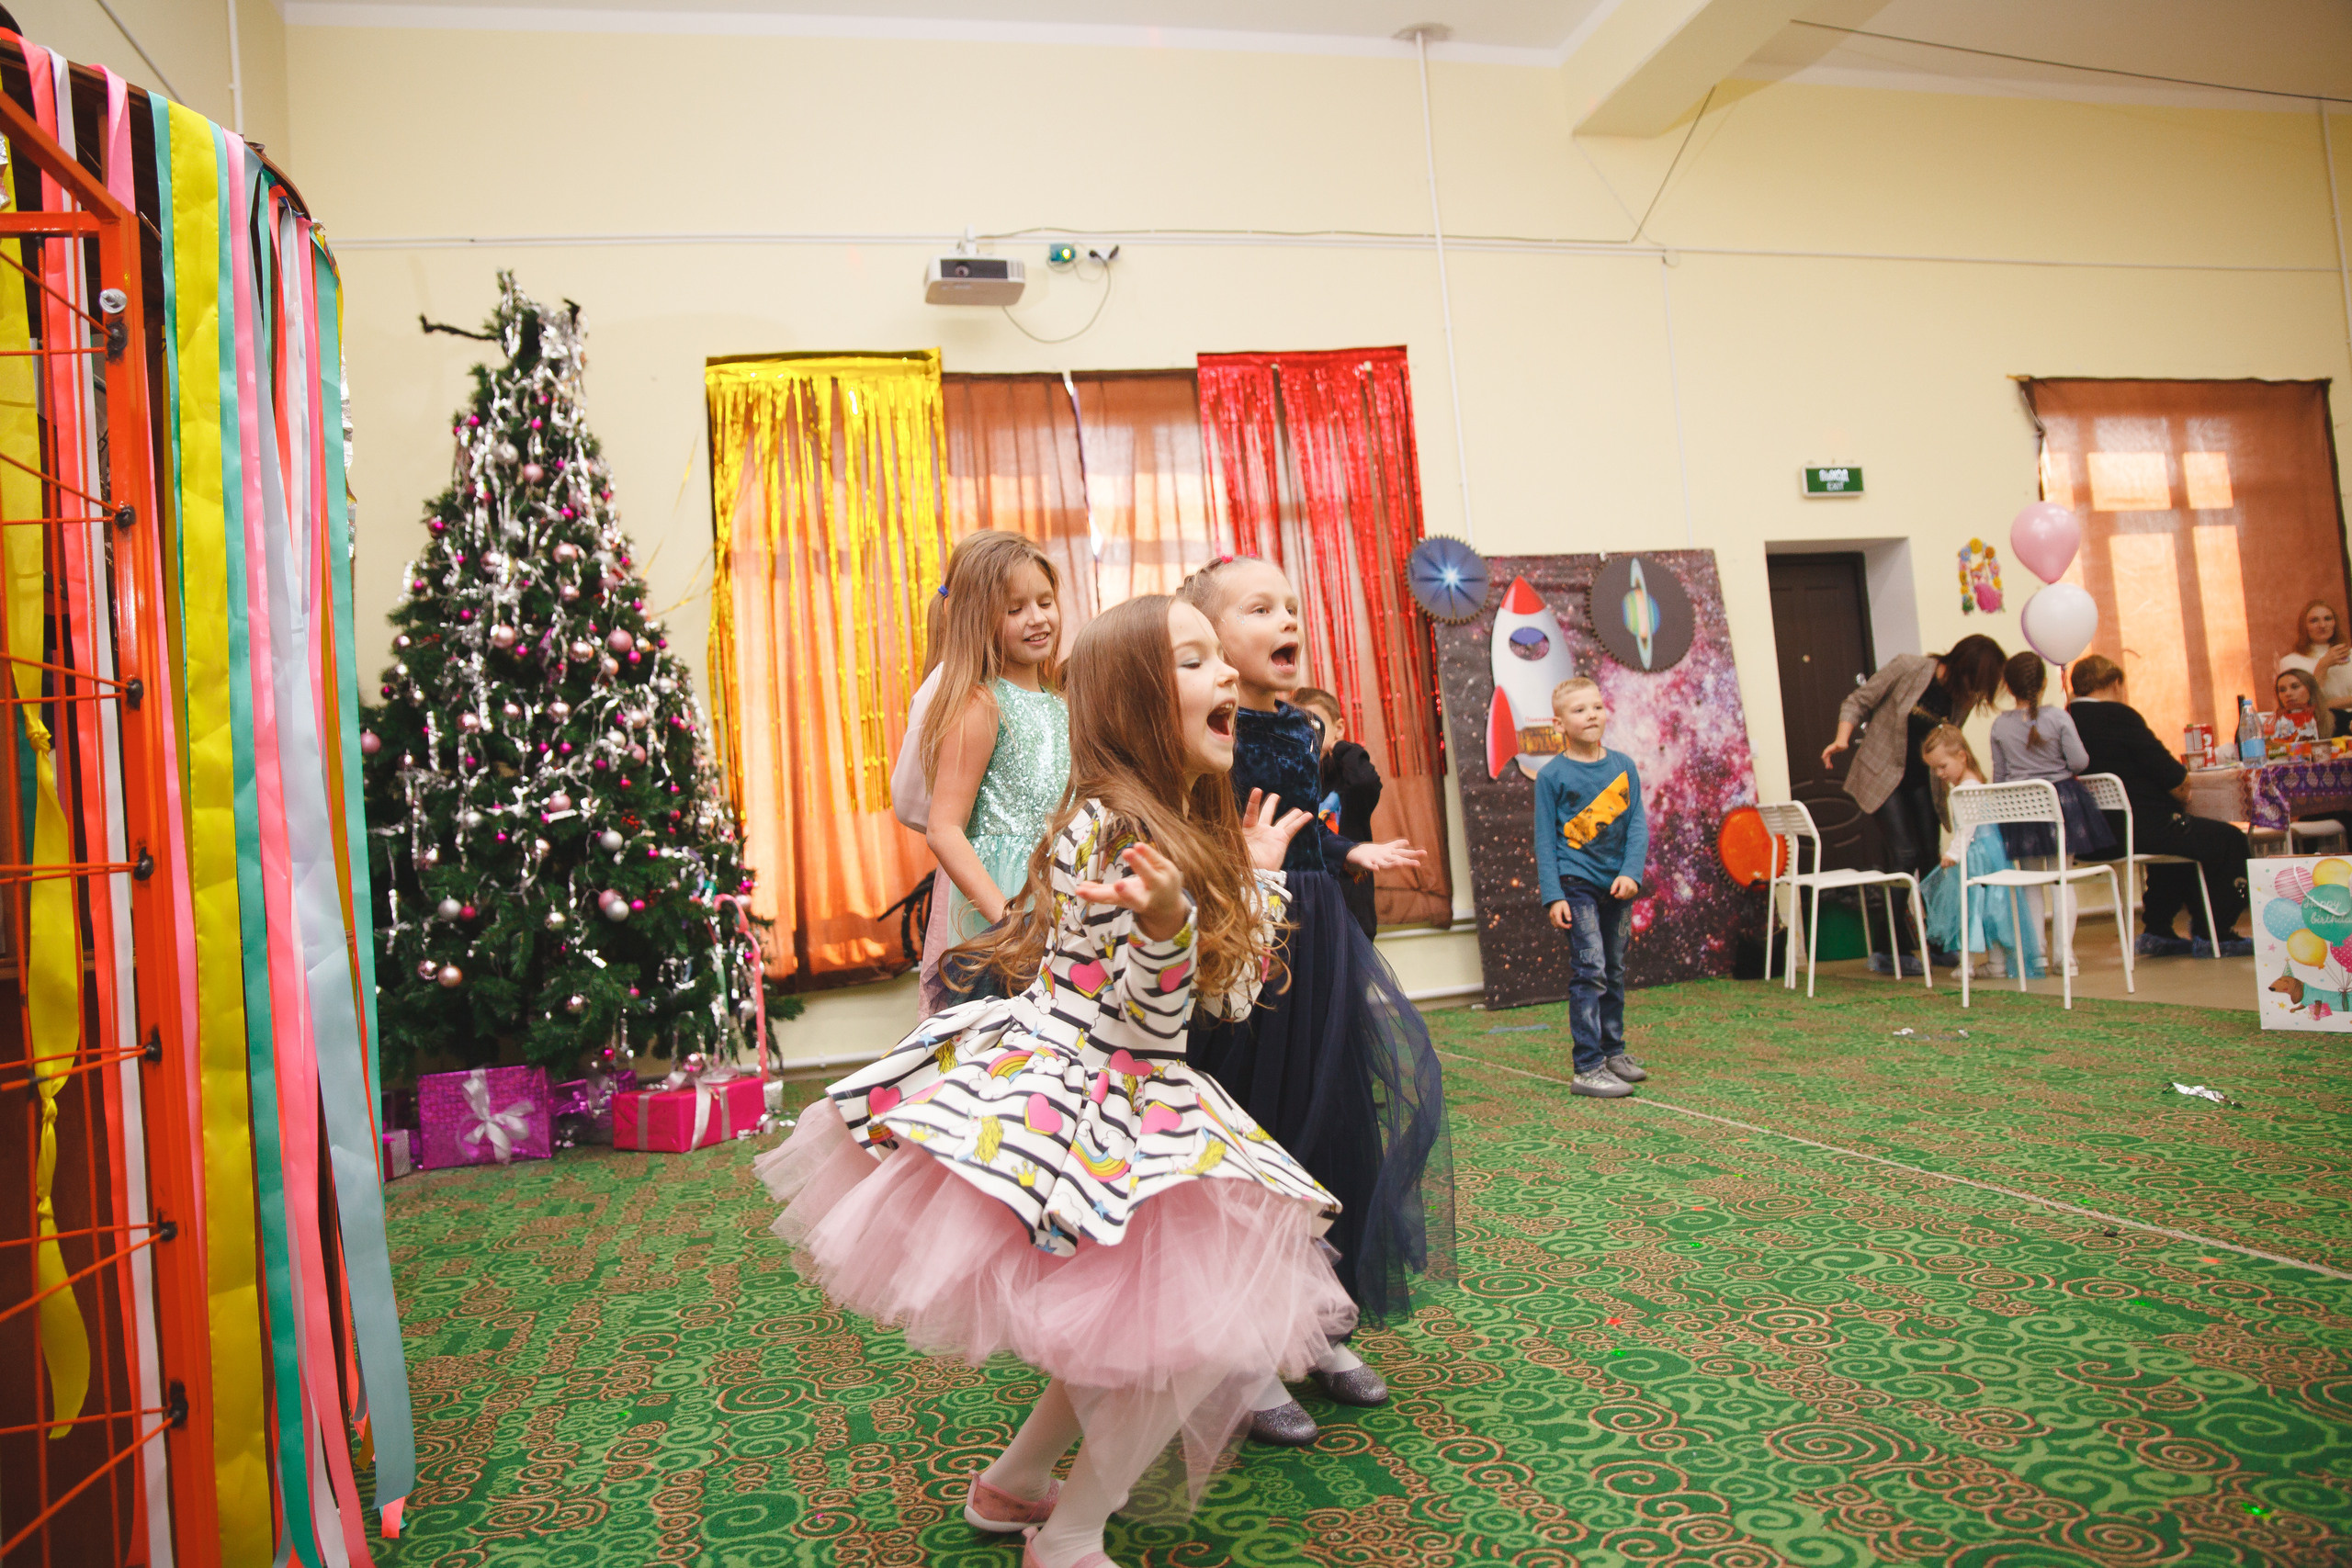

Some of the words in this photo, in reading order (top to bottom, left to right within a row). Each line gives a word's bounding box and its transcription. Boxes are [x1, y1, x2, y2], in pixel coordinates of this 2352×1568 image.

[1819, 468, 1849, 482] ВЫХОД
[1826, 481, 1845, 491] EXIT
[2311, 911, 2352, 924] birthda
